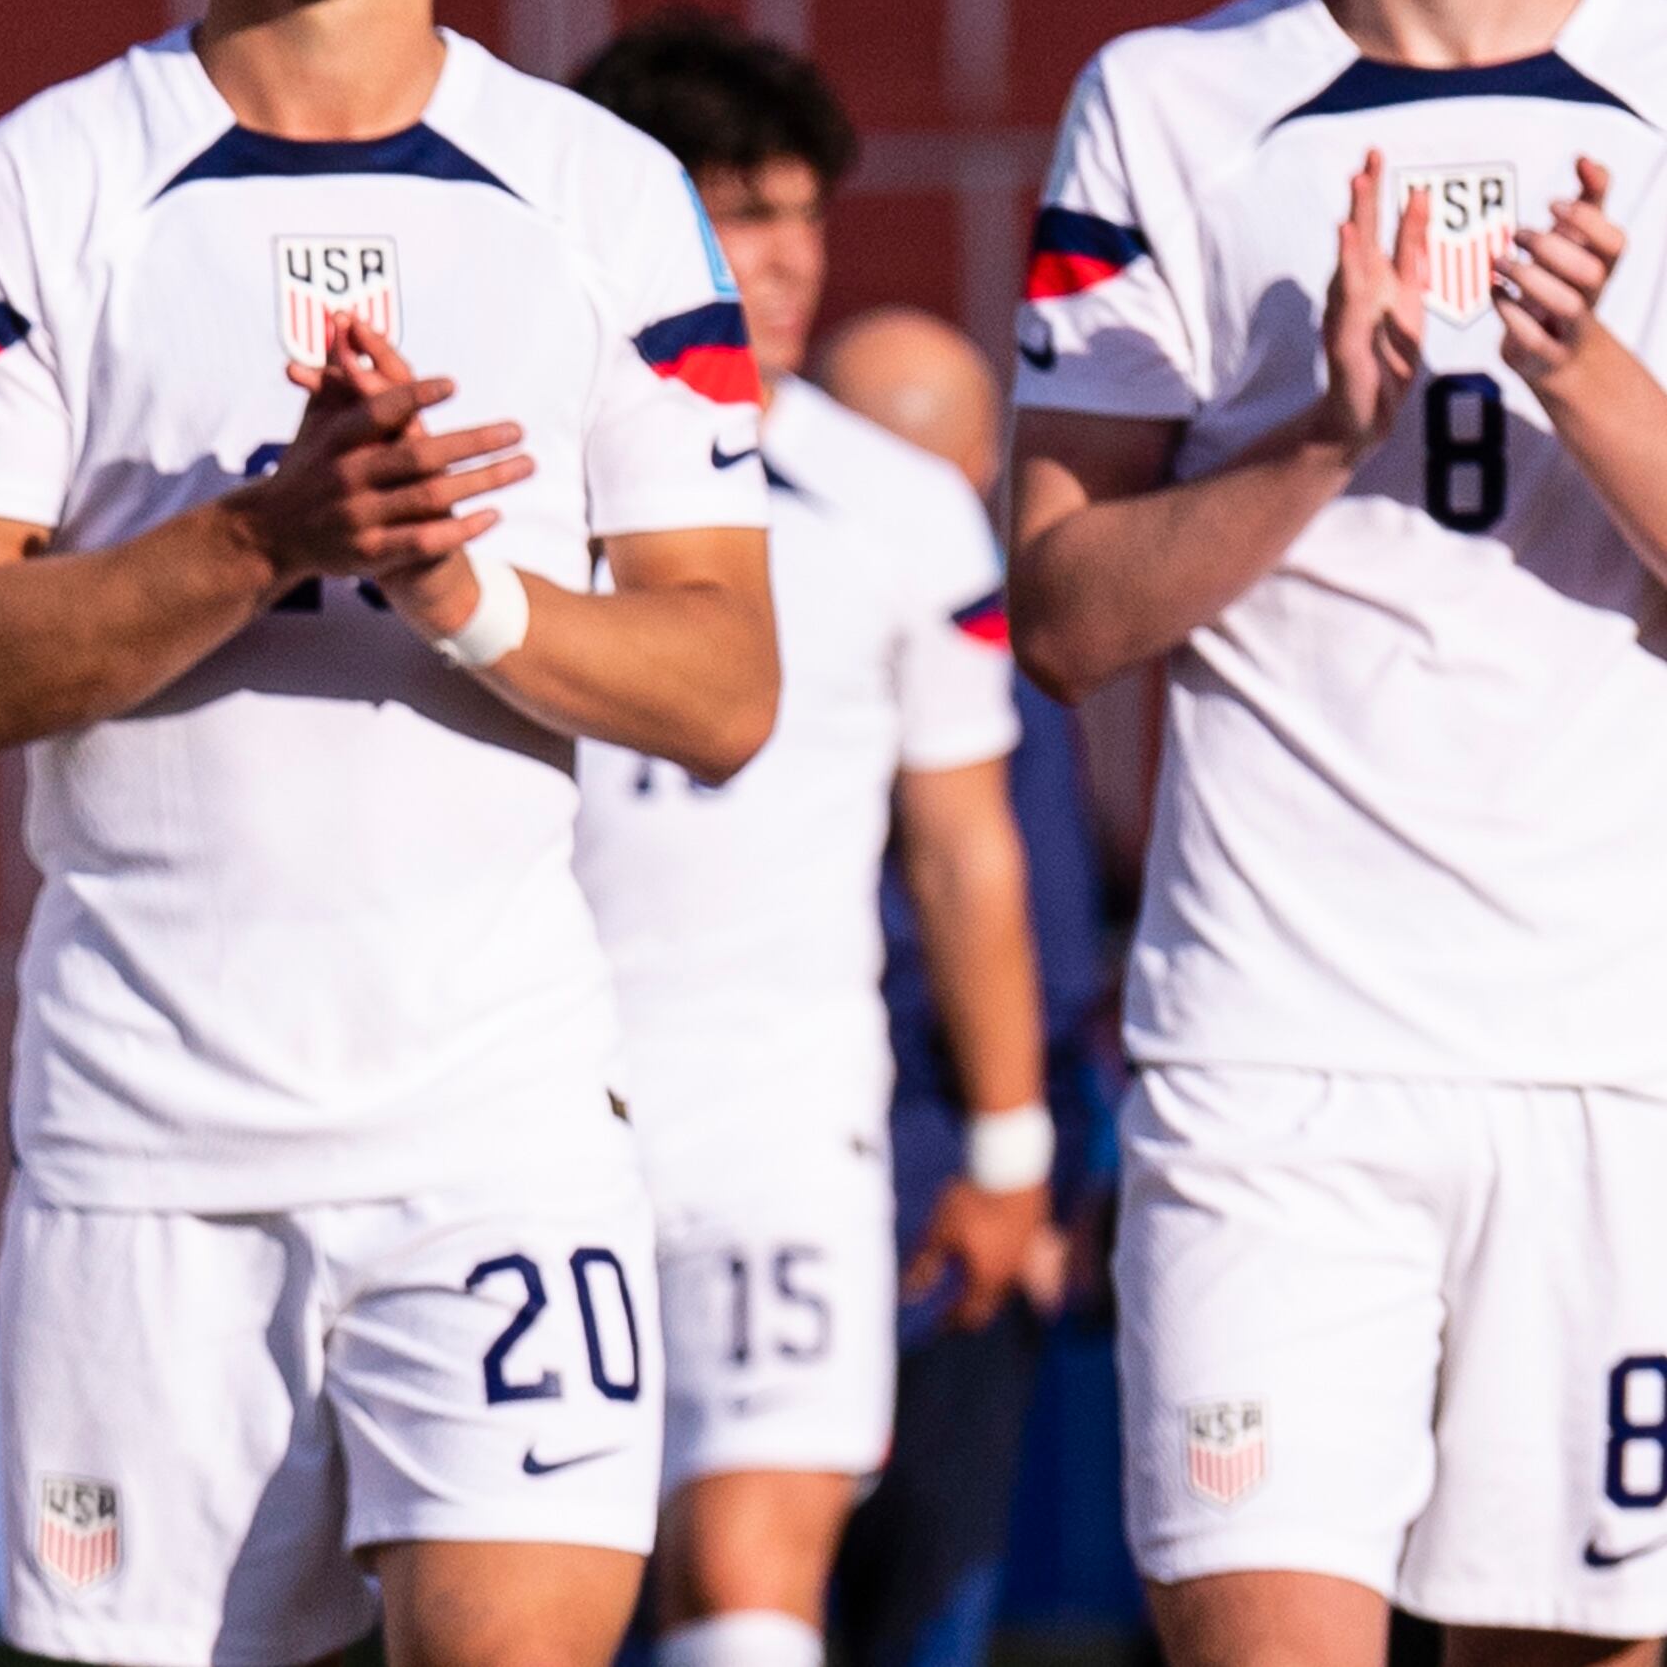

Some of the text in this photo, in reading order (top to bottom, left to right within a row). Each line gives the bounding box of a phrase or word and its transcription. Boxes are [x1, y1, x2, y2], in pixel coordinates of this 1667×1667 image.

[285, 246, 385, 295] USA
[1425, 372, 1509, 534] 8
[465, 1247, 641, 1406] 20
[727, 1244, 835, 1368] 15
[1605, 1355, 1667, 1508] 8
[48, 1481, 117, 1527] USA
